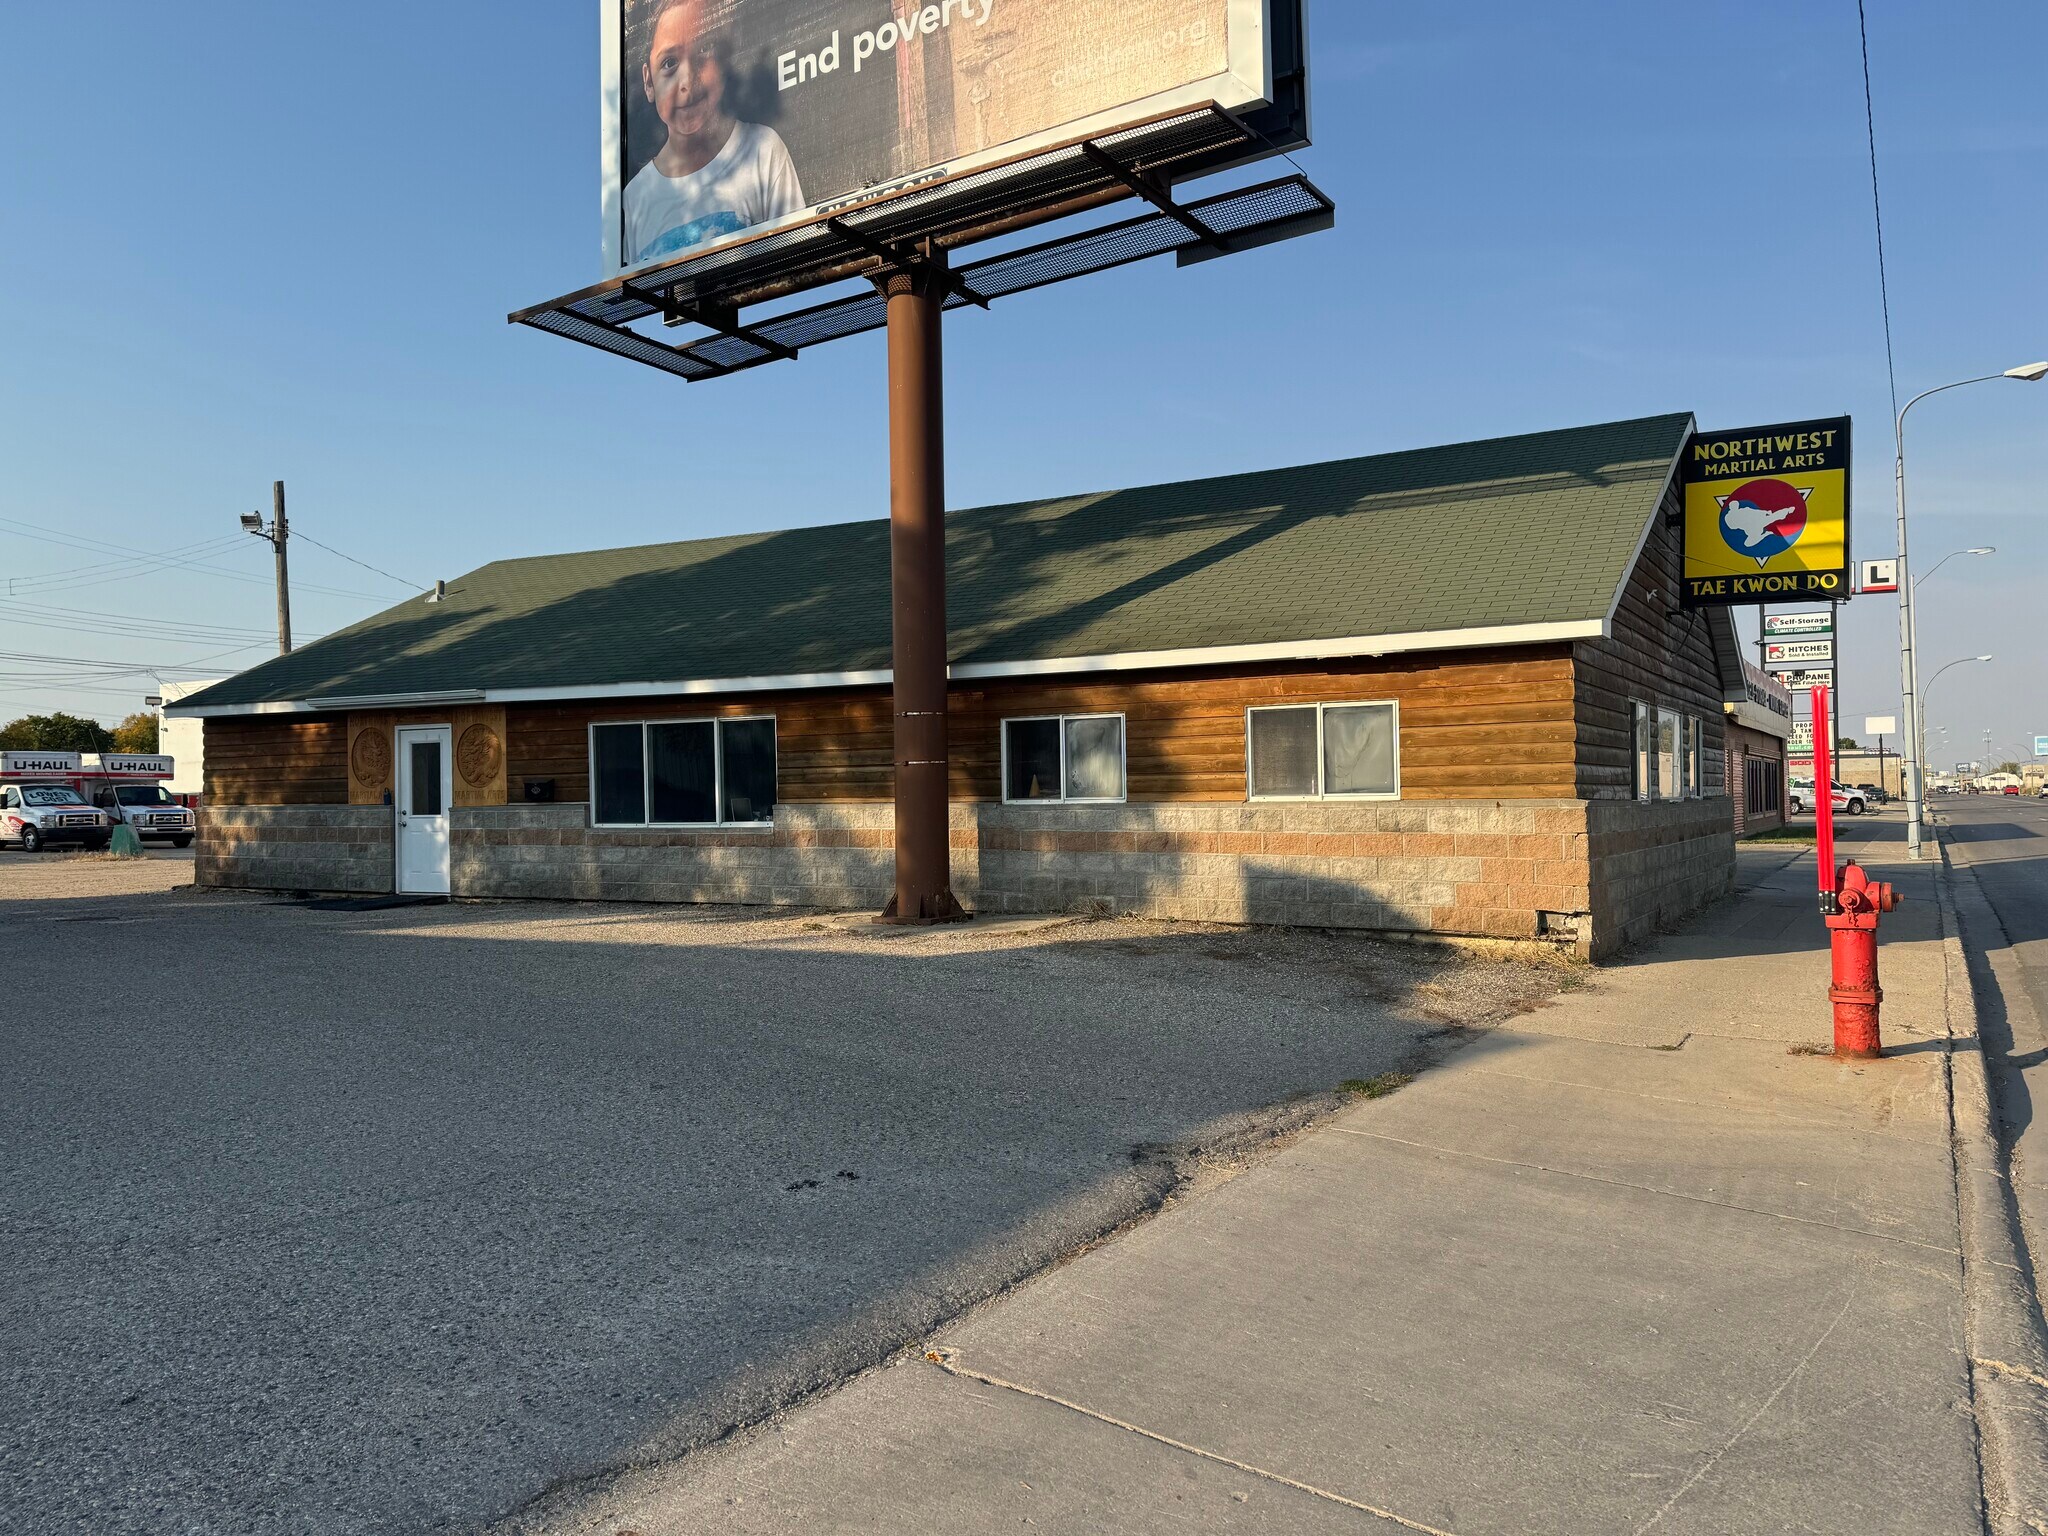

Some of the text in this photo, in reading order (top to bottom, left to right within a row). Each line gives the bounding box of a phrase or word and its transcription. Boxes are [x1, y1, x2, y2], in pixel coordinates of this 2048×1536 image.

[777, 0, 994, 92] End poverty
[1694, 429, 1837, 461] NORTHWEST
[1704, 452, 1826, 476] MARTIAL ARTS
[1690, 573, 1839, 596] TAE KWON DO
[1788, 645, 1829, 653] HITCHES
[13, 760, 73, 770] U-HAUL
[110, 762, 166, 772] U-HAUL
[29, 790, 72, 799] LOWEST
[42, 795, 68, 803] COST
